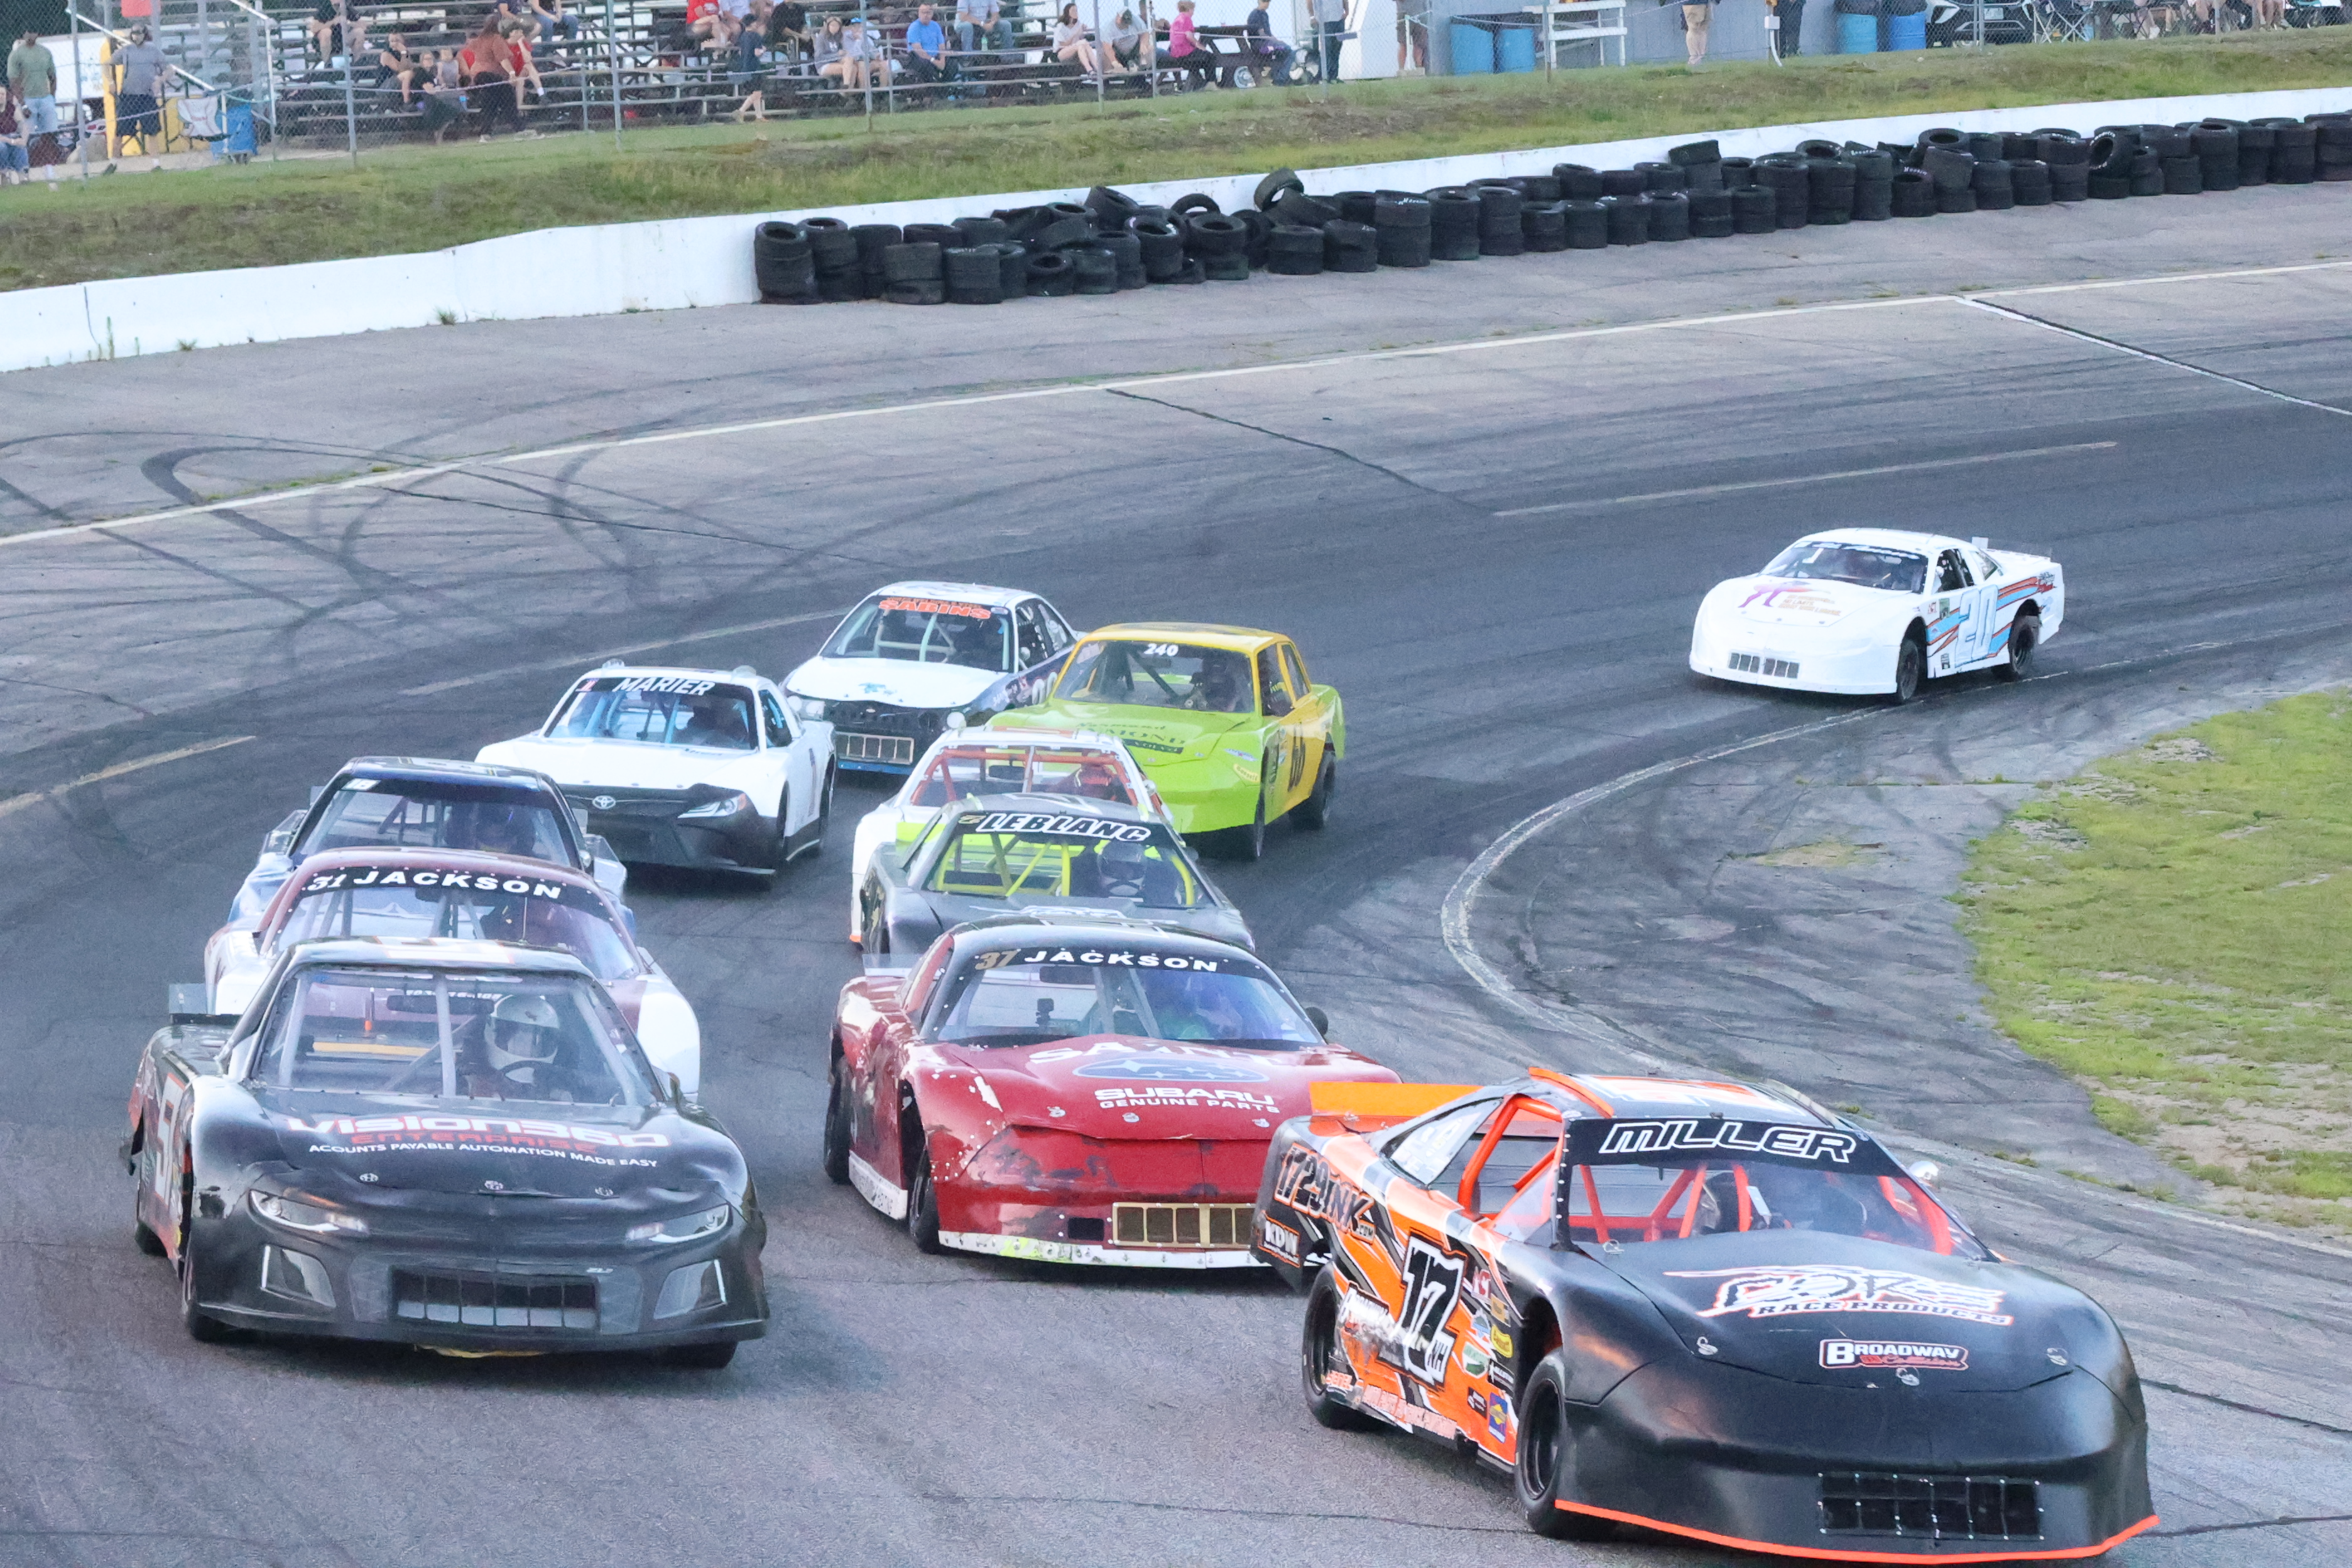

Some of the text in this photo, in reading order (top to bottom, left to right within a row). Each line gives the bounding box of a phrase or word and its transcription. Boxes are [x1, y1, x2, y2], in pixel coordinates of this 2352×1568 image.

[878, 599, 991, 619] SABINS
[1955, 584, 1998, 668] 20
[1143, 643, 1179, 657] 240
[611, 677, 716, 696] MARIER
[975, 813, 1152, 842] LEBLANC
[353, 871, 561, 899] JACKSON
[974, 950, 1217, 972] 37 JACKSON
[1094, 1087, 1275, 1106] SUBARU
[1099, 1097, 1280, 1114] GENUINE PARTS
[1598, 1121, 1856, 1163] MILLER
[459, 1144, 566, 1158] AUTOMATION
[570, 1152, 616, 1166] MADE
[619, 1158, 658, 1168] EASY
[1265, 1221, 1298, 1255] KDW
[1396, 1239, 1464, 1373] 17
[1759, 1300, 2008, 1326] RACE PRODUCTS
[1826, 1342, 1959, 1364] BROADWAY
